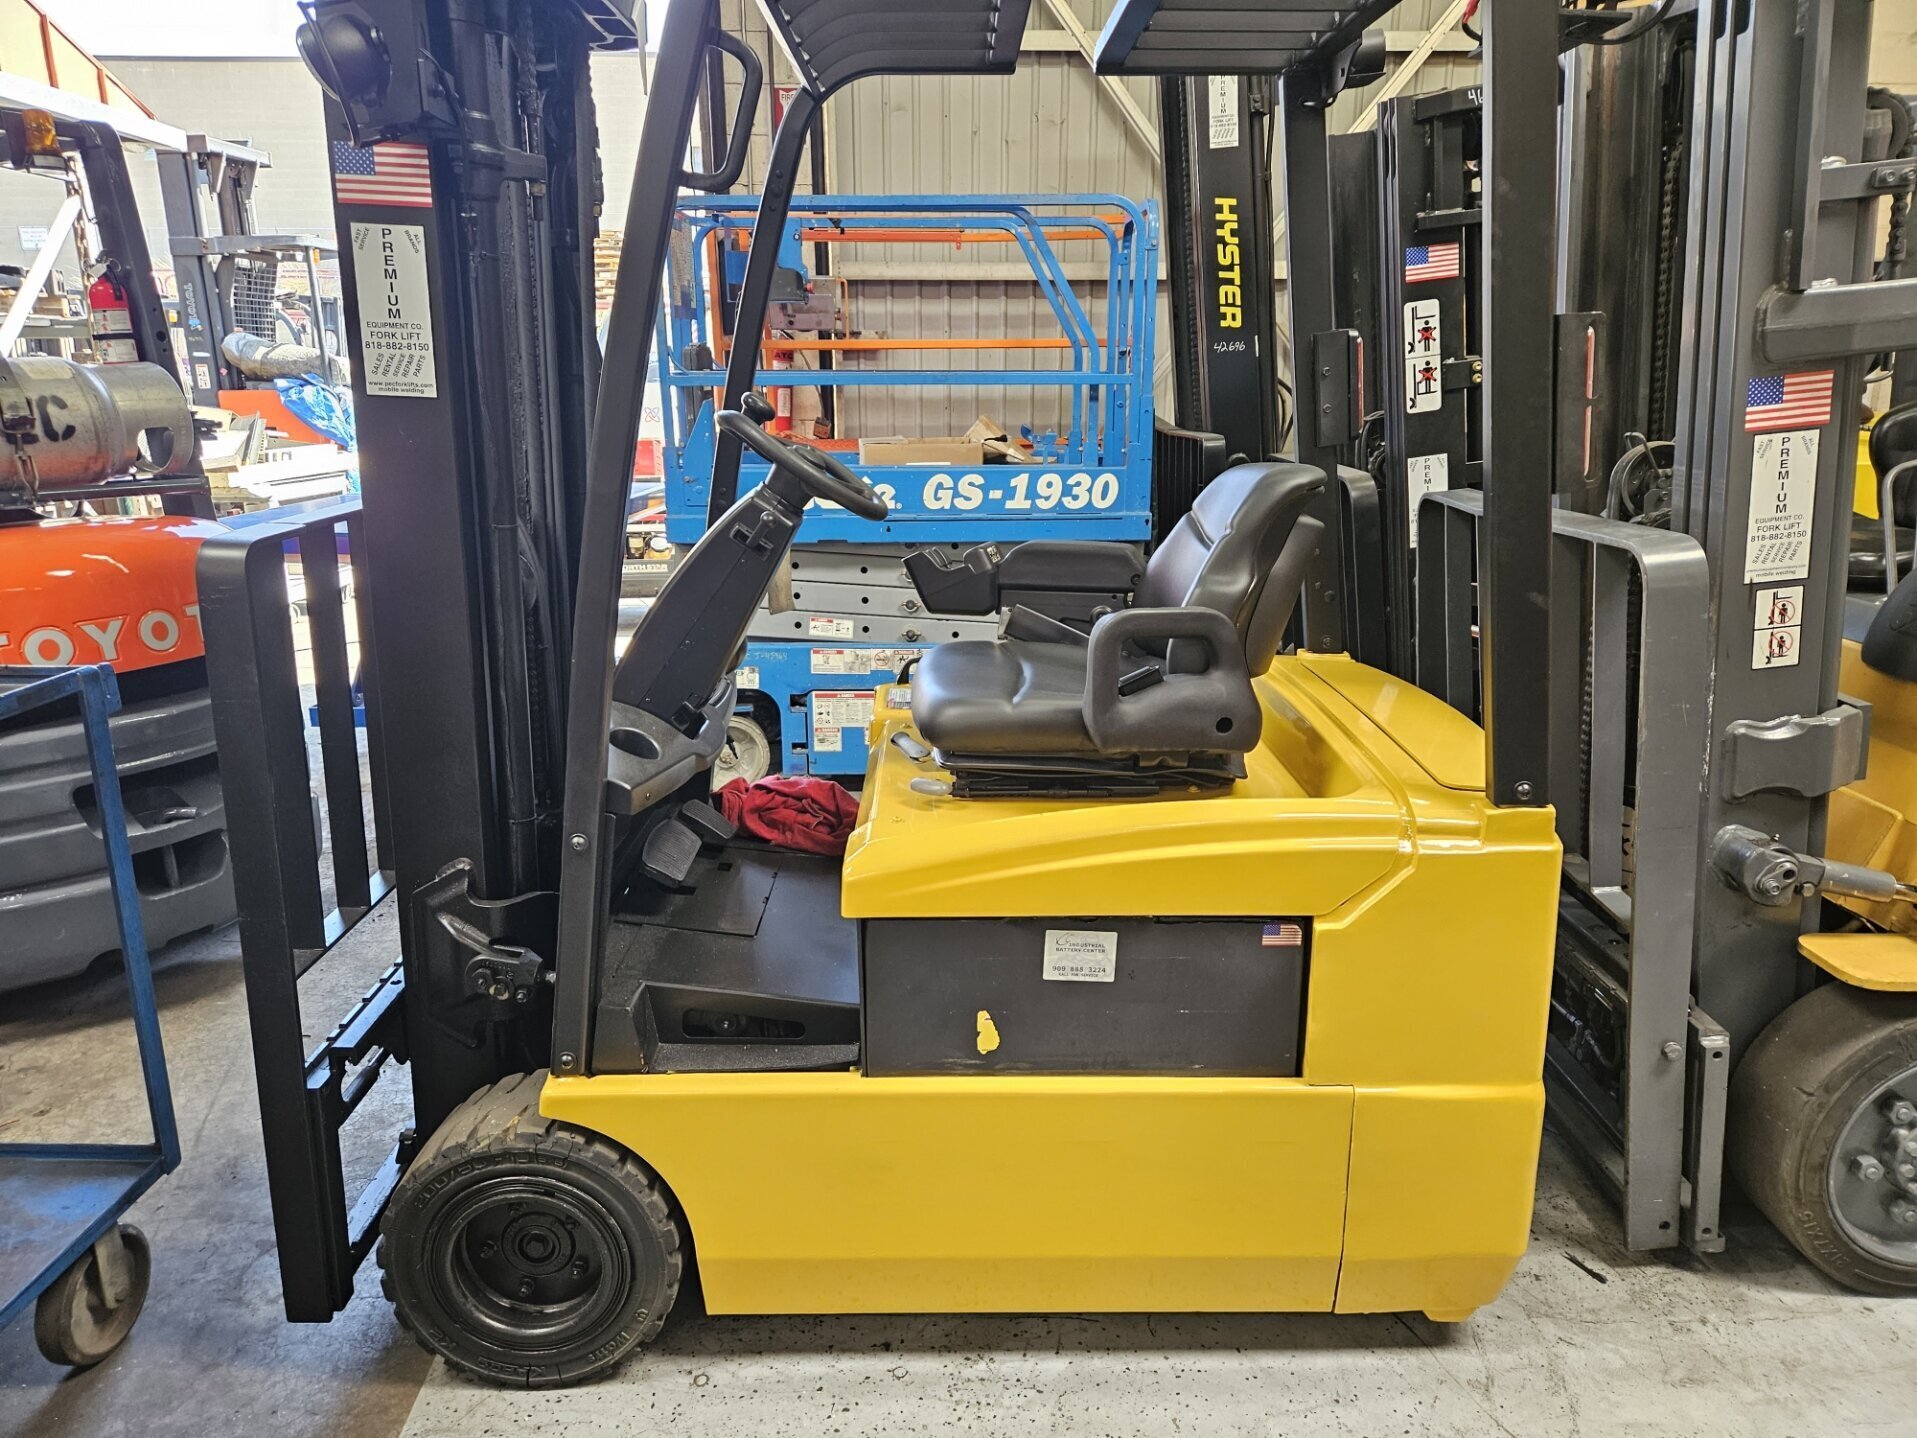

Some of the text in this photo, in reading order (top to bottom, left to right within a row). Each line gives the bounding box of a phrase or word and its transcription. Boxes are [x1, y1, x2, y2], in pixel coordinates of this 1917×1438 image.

[358, 227, 370, 250] SERVICE
[381, 228, 401, 319] PREMIUM
[1214, 197, 1242, 328] HYSTER
[366, 321, 409, 330] EQUIPMENT
[370, 331, 421, 340] FORK LIFT
[365, 341, 430, 351] 818-882-8150
[371, 352, 384, 375] SALES
[381, 353, 396, 377] RENTAL
[392, 352, 406, 377] SERVICE
[401, 353, 415, 378] REPAIR
[412, 354, 426, 377] PARTS
[1424, 457, 1432, 491] PREMI
[1775, 436, 1791, 514] PREMIUM
[923, 472, 1120, 510] GS-1930
[1755, 515, 1792, 524] EQUIPMENT
[1757, 522, 1801, 533] FORK LIFT
[1751, 530, 1807, 542] 818-882-8150
[1752, 544, 1766, 564] SALES
[1761, 543, 1777, 564] RENTAL
[1778, 541, 1793, 562] REPAIR
[1788, 540, 1803, 561] PARTS
